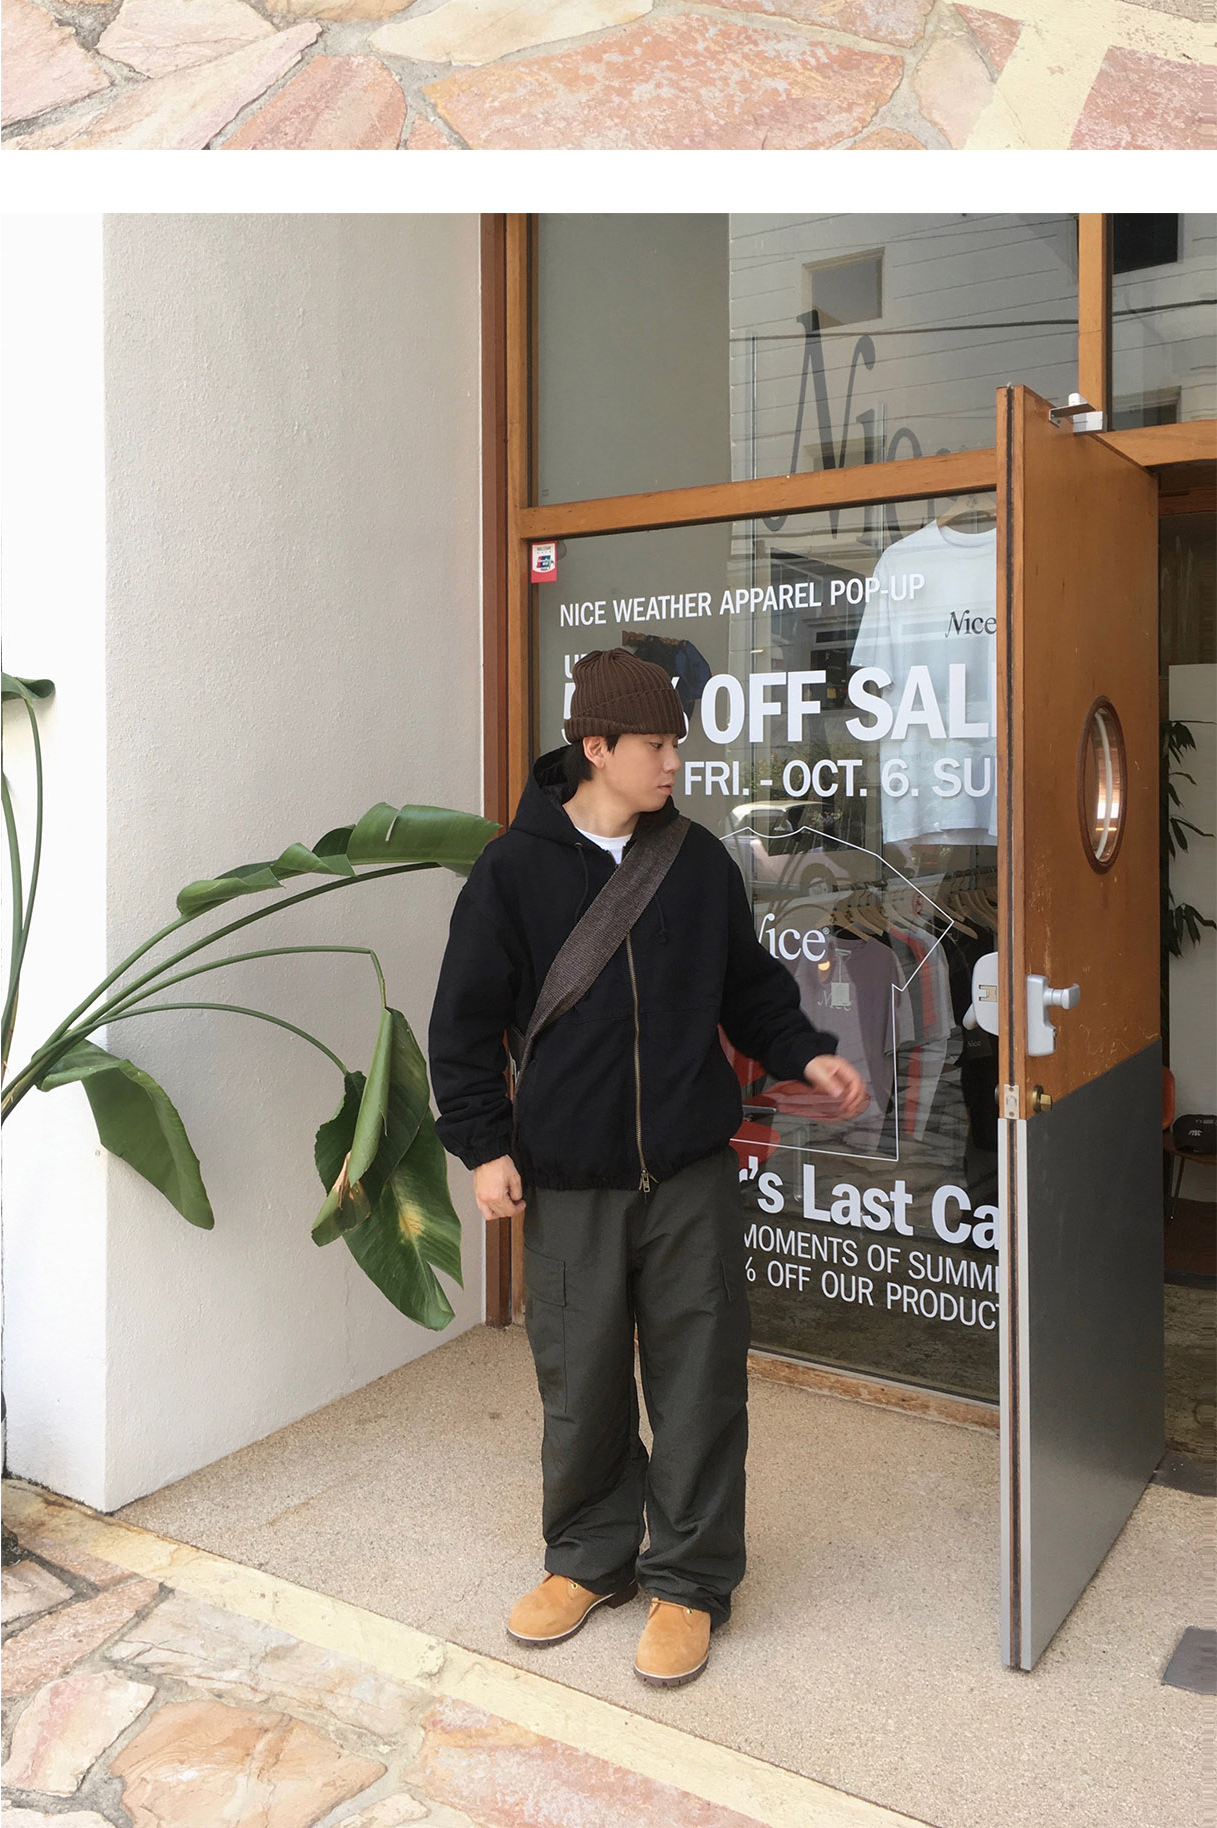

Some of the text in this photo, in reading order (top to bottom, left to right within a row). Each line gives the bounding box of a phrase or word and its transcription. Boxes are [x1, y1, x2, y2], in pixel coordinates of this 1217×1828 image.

[560, 573, 925, 627] NICE WEATHER APPAREL POP-UP
[945, 609, 997, 638] Nice
[700, 669, 826, 745] OFF
[845, 663, 997, 741] SAL
[684, 760, 750, 796] FRI.
[782, 759, 867, 798] OCT.
[881, 758, 919, 797] 6.
[932, 757, 997, 797] SU
[803, 1163, 914, 1236] Last
[767, 1260, 811, 1292] OFF
[821, 1270, 874, 1306] OUR
[886, 1282, 998, 1330] PRODUC
[867, 1244, 901, 1273] OF
[908, 1251, 998, 1293] SUMM
